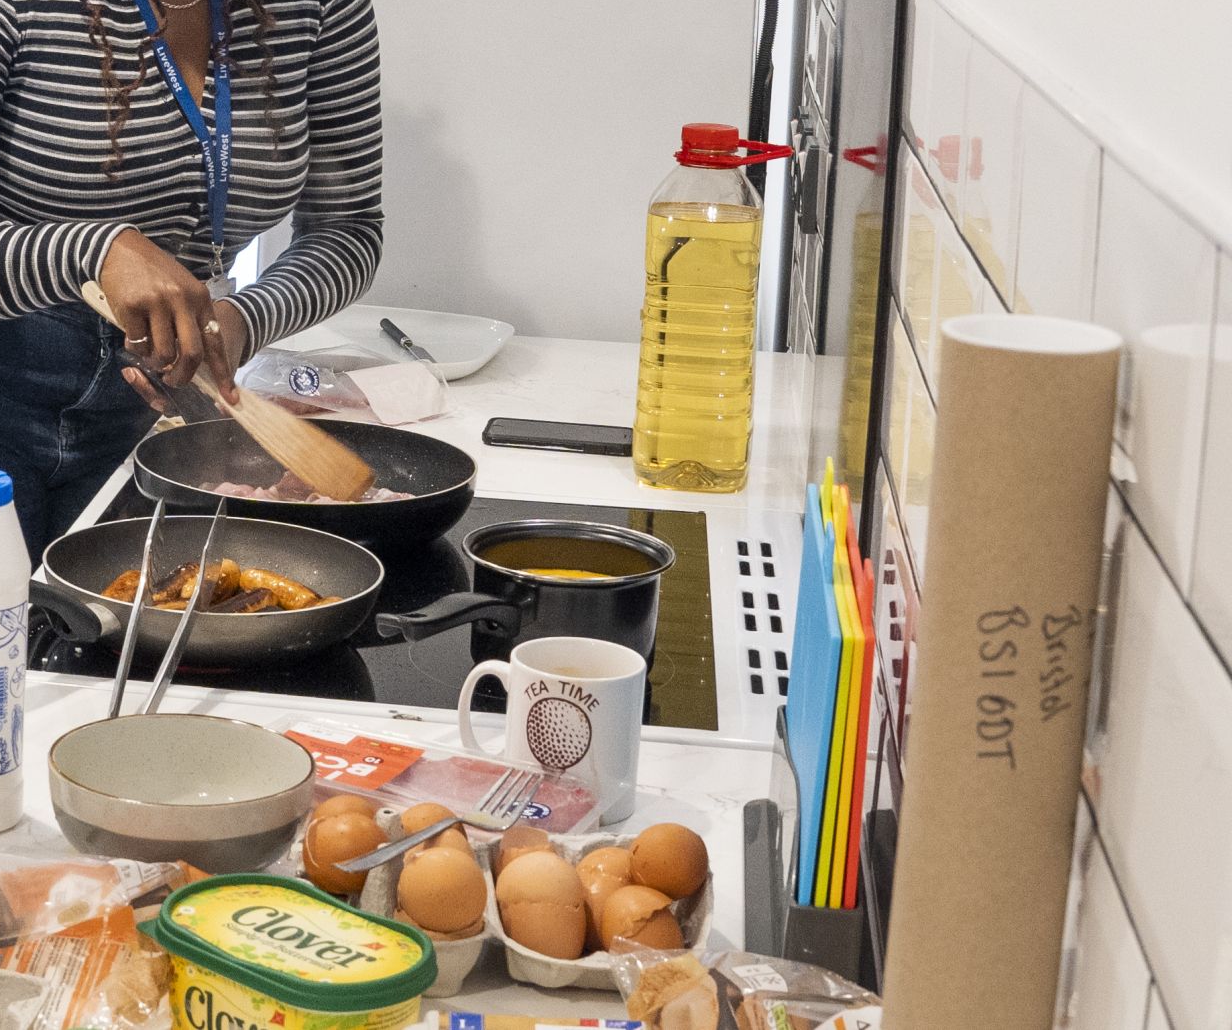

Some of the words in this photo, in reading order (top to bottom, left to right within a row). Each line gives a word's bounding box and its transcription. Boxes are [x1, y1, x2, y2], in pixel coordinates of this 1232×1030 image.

[157, 46, 183, 93] LiveWest
[201, 140, 216, 189] LiveWest
[220, 134, 229, 182] LiveWest
[524, 679, 549, 701] TEA
[558, 680, 601, 713] TIME
[976, 694, 1017, 770] 6DT
[231, 905, 377, 968] Clover
